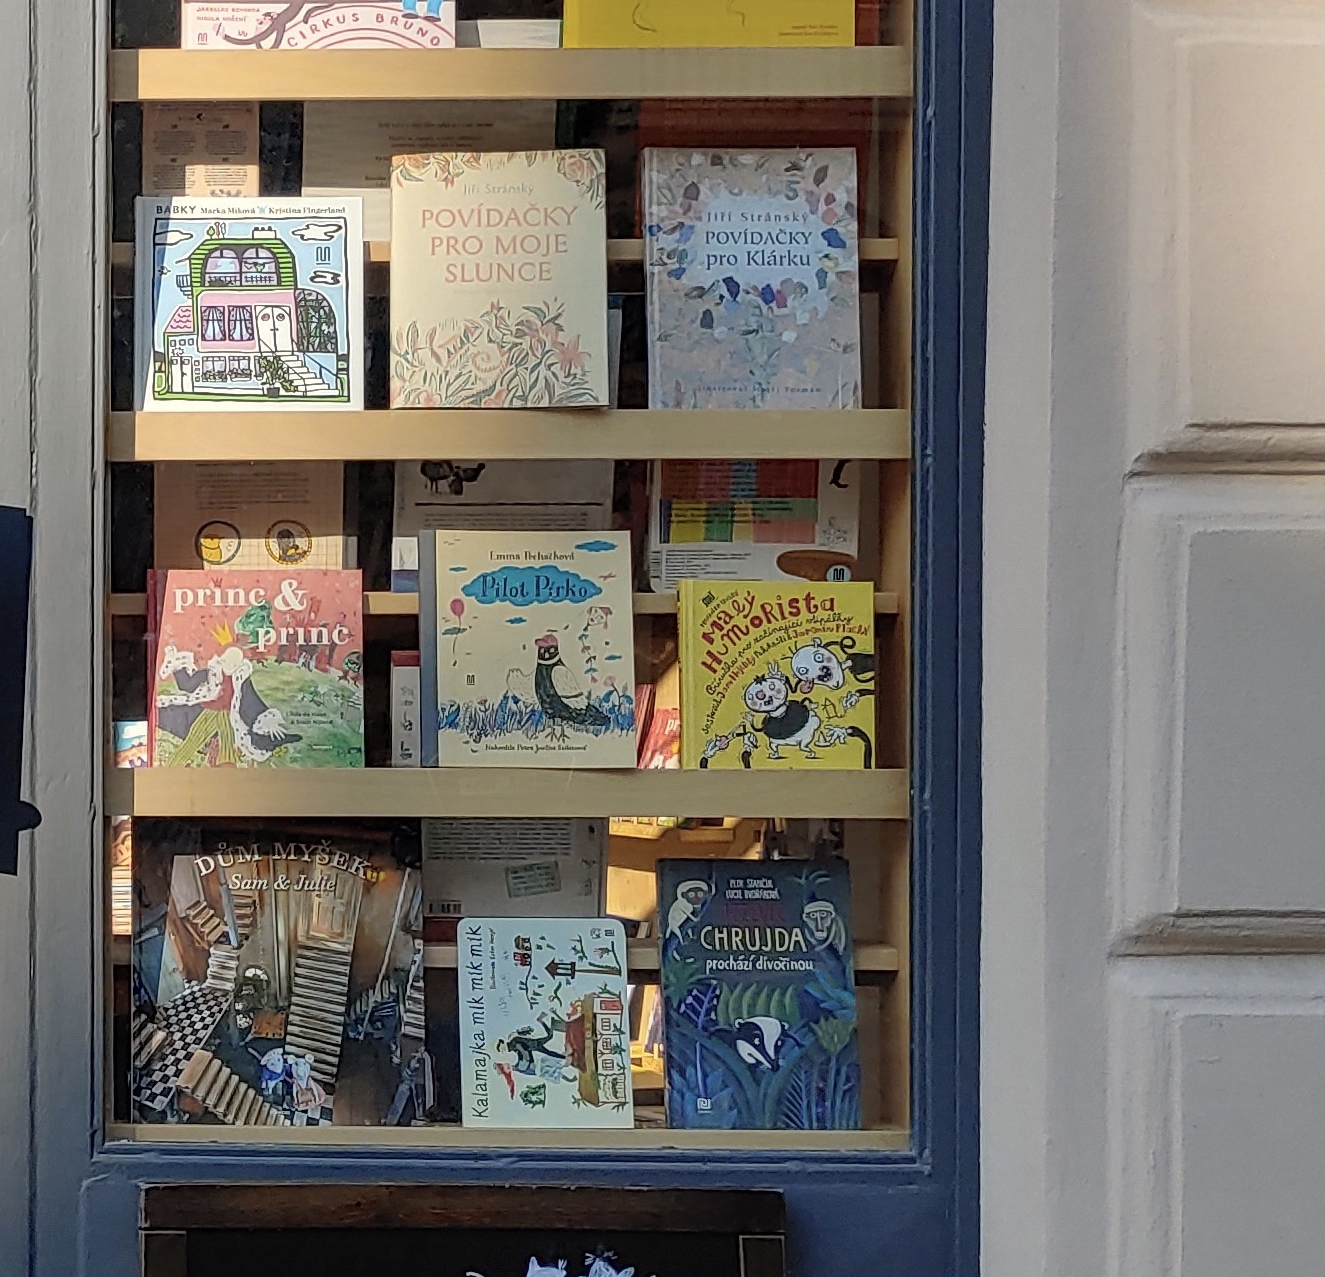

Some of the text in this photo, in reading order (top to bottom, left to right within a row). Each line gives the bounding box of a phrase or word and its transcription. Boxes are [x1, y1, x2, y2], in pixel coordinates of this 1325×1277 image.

[287, 11, 442, 48] CIRKUS BRUNO
[156, 204, 197, 215] BABKY
[420, 202, 578, 229] POVÍDAČKY
[430, 233, 569, 257] PRO MOJE
[705, 228, 813, 246] POVÍDAČKY
[445, 260, 553, 284] SLUNCE
[706, 249, 812, 271] pro Klárku
[172, 578, 309, 614] princ &
[480, 574, 589, 599] Pilot Pírko
[255, 623, 352, 653] princ
[193, 839, 374, 880] DŮM MYŠEK
[228, 873, 336, 892] Sam & Julie
[700, 925, 808, 953] CHRUJDA
[705, 954, 814, 975] prochází divočinou
[469, 1029, 492, 1119] Kalamajka
